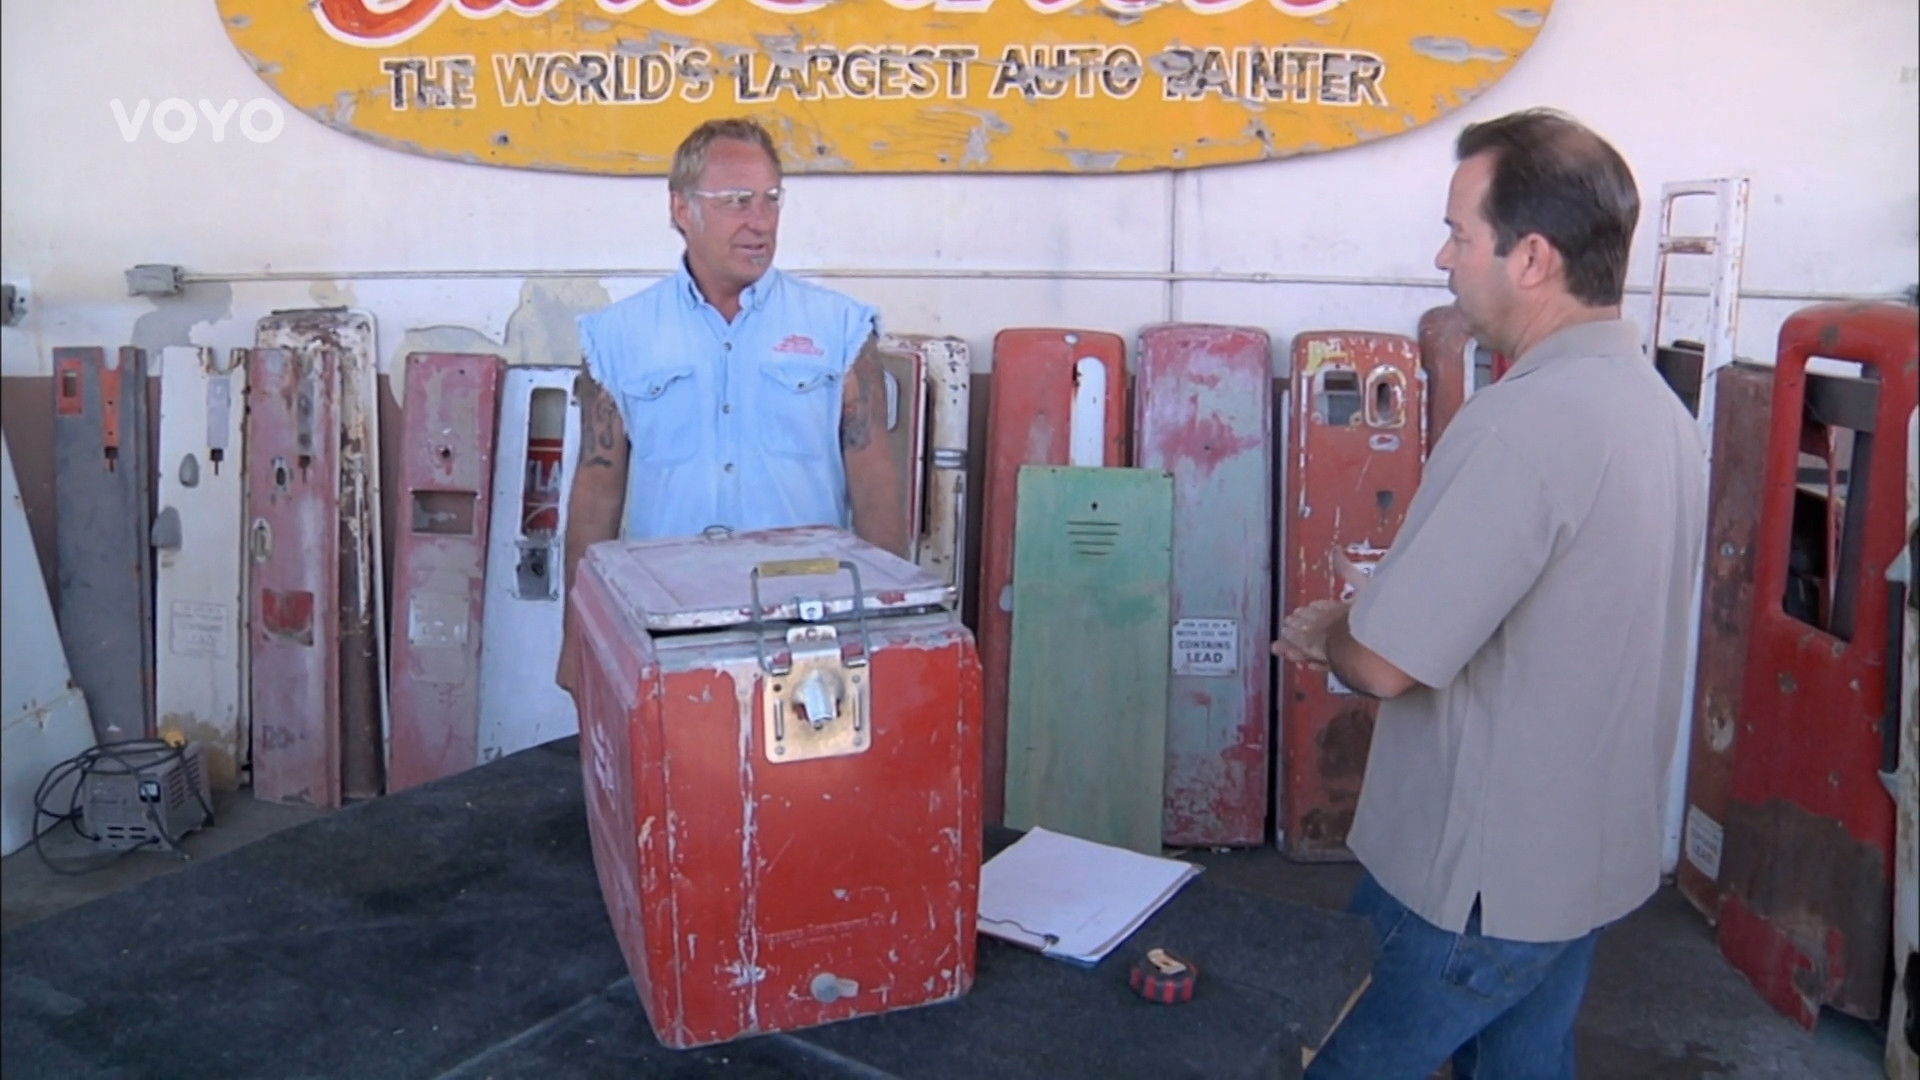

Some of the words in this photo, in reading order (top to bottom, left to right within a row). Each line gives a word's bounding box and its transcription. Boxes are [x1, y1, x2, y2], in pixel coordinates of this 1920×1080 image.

[381, 55, 477, 110] THE
[492, 45, 714, 105] WORLD'S
[735, 45, 979, 103] LARGEST
[988, 44, 1144, 101] AUTO
[1186, 652, 1223, 663] LEAD
